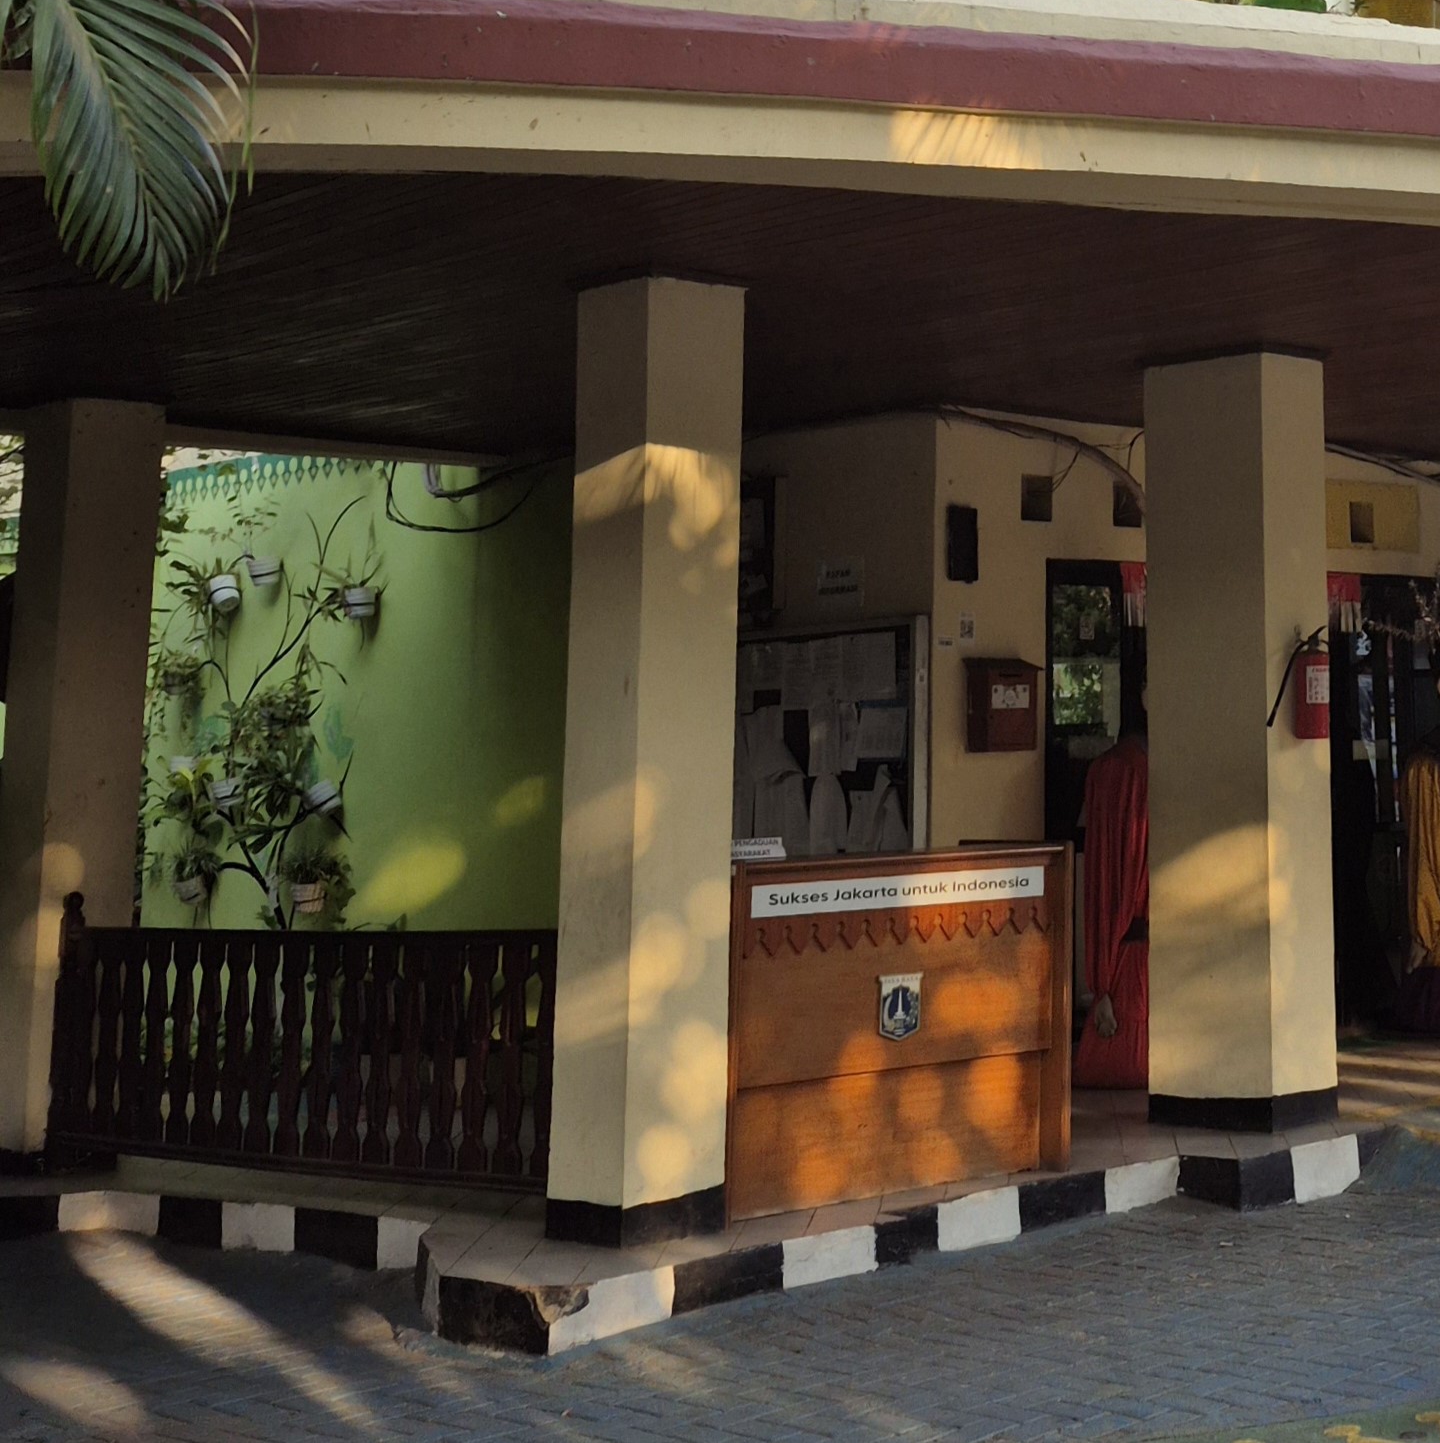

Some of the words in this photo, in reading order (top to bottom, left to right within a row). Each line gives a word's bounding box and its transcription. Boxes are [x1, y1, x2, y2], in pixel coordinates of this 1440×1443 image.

[768, 891, 829, 906] Sukses
[833, 886, 898, 902] Jakarta
[901, 882, 948, 897] untuk
[952, 875, 1030, 893] Indonesia
